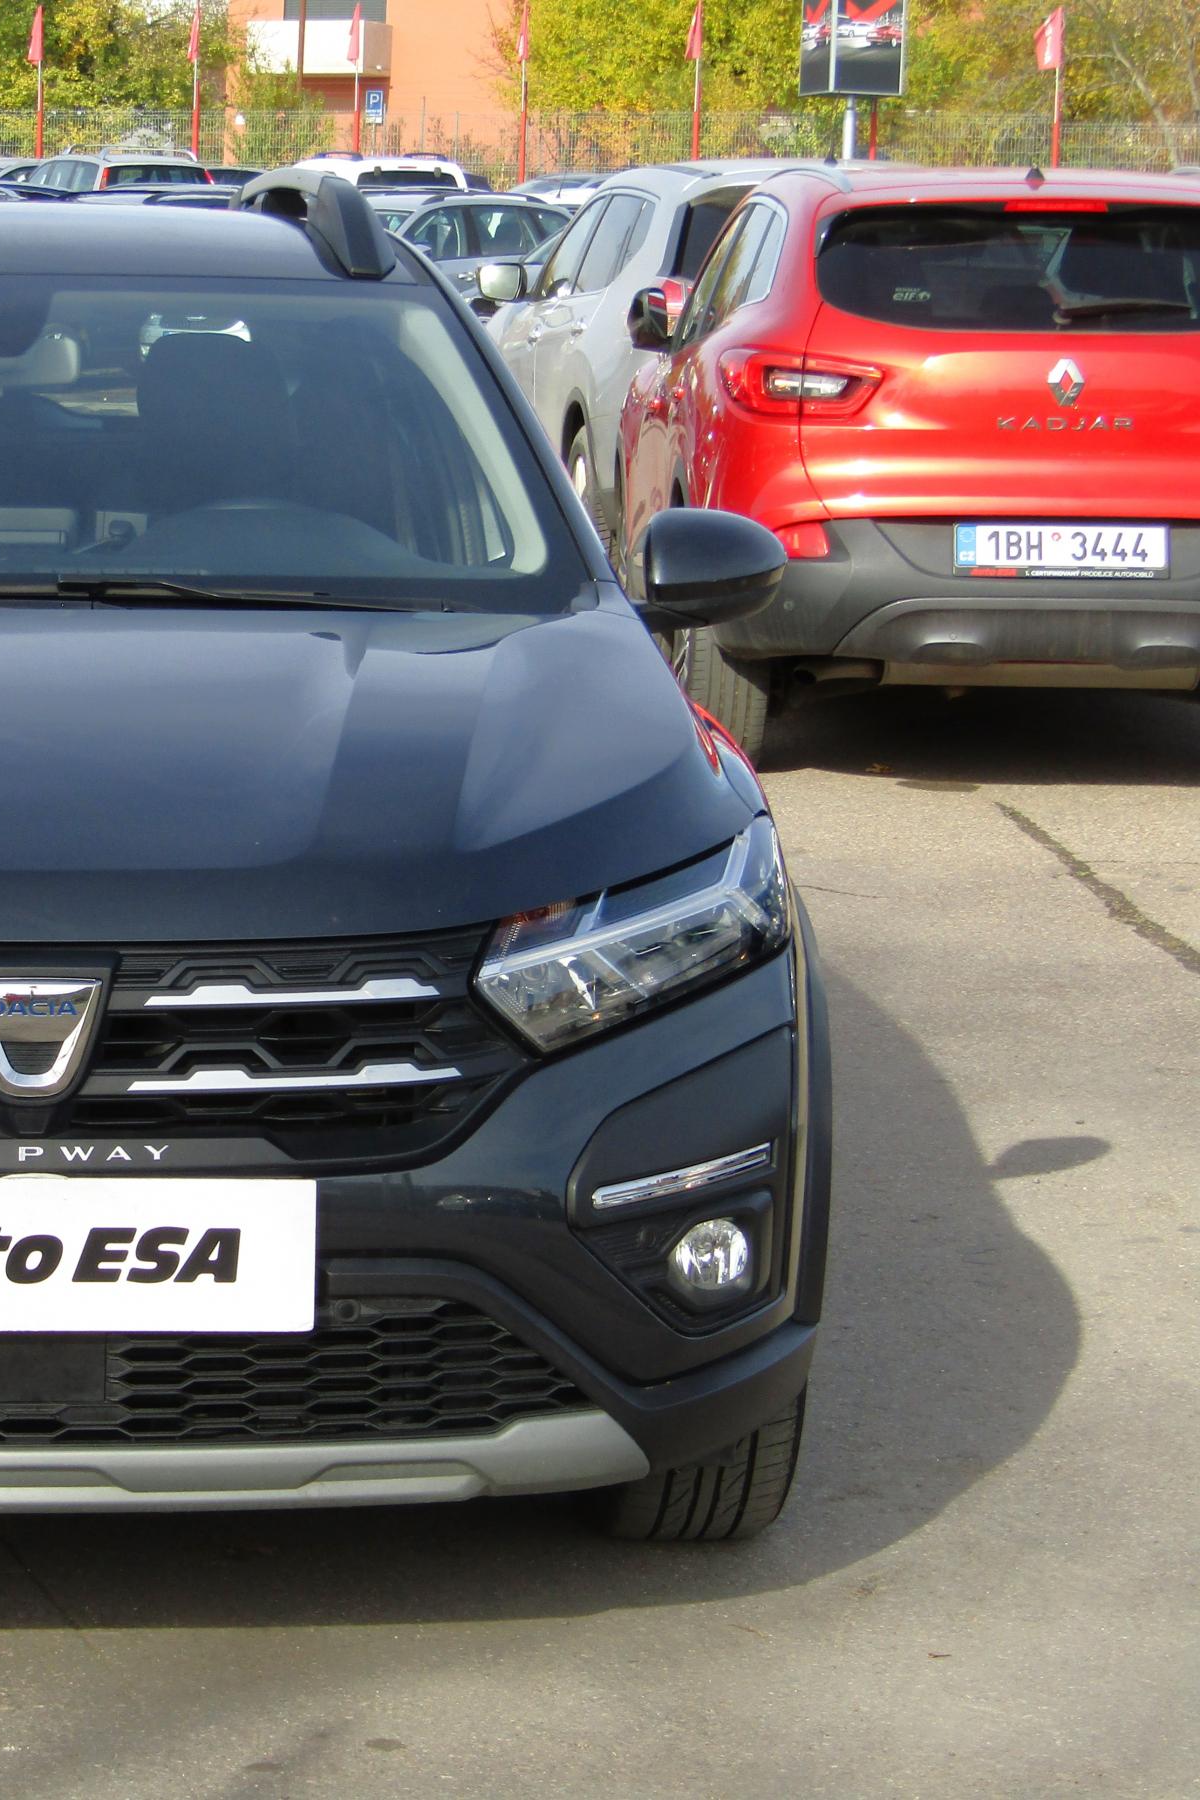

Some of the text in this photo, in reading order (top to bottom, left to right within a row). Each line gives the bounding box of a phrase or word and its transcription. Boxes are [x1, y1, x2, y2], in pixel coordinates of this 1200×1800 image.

[370, 93, 380, 108] P
[997, 416, 1135, 431] KADJAR
[987, 530, 1149, 562] 1BH 3444
[959, 551, 976, 562] CZ
[71, 1226, 241, 1284] ESA
